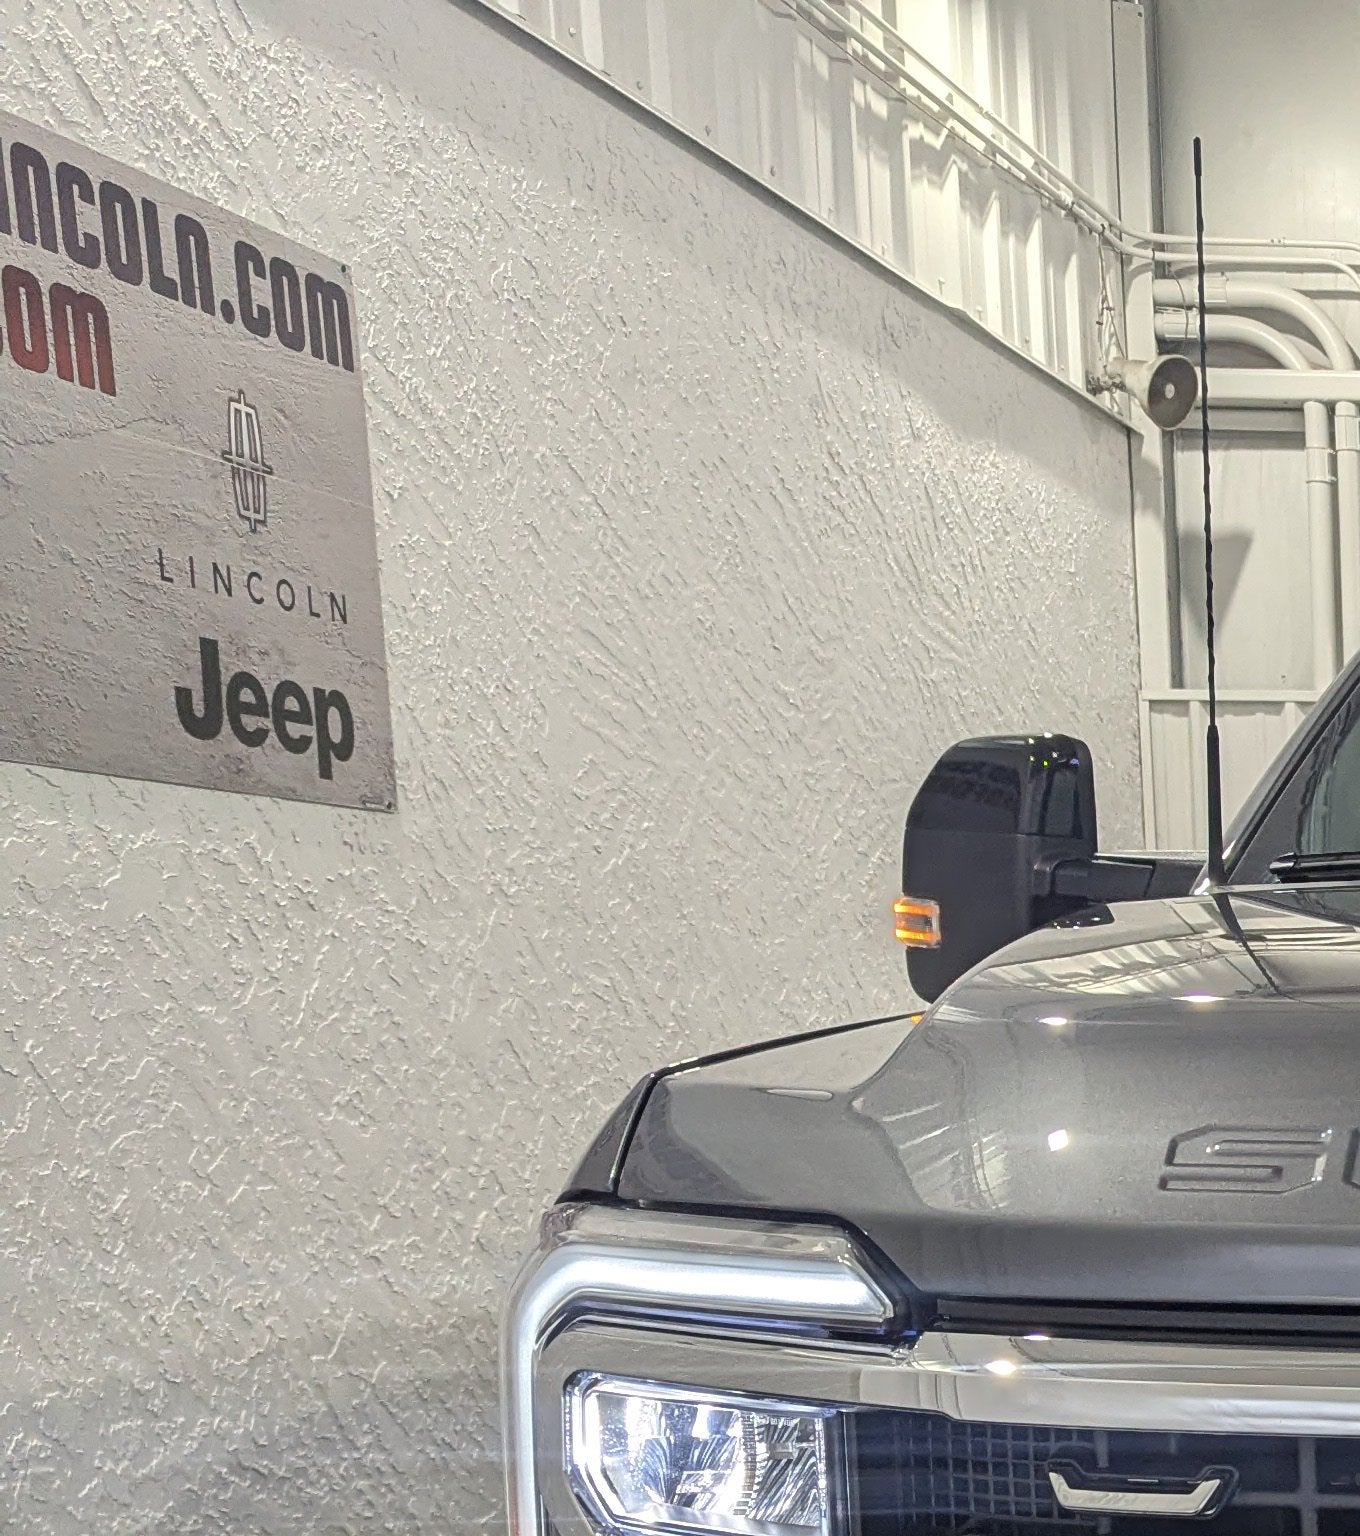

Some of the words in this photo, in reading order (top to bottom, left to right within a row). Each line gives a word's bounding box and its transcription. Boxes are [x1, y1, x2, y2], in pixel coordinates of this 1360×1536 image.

[0, 264, 117, 397] OM
[157, 547, 348, 625] LINCOLN
[173, 636, 356, 781] Jeep
